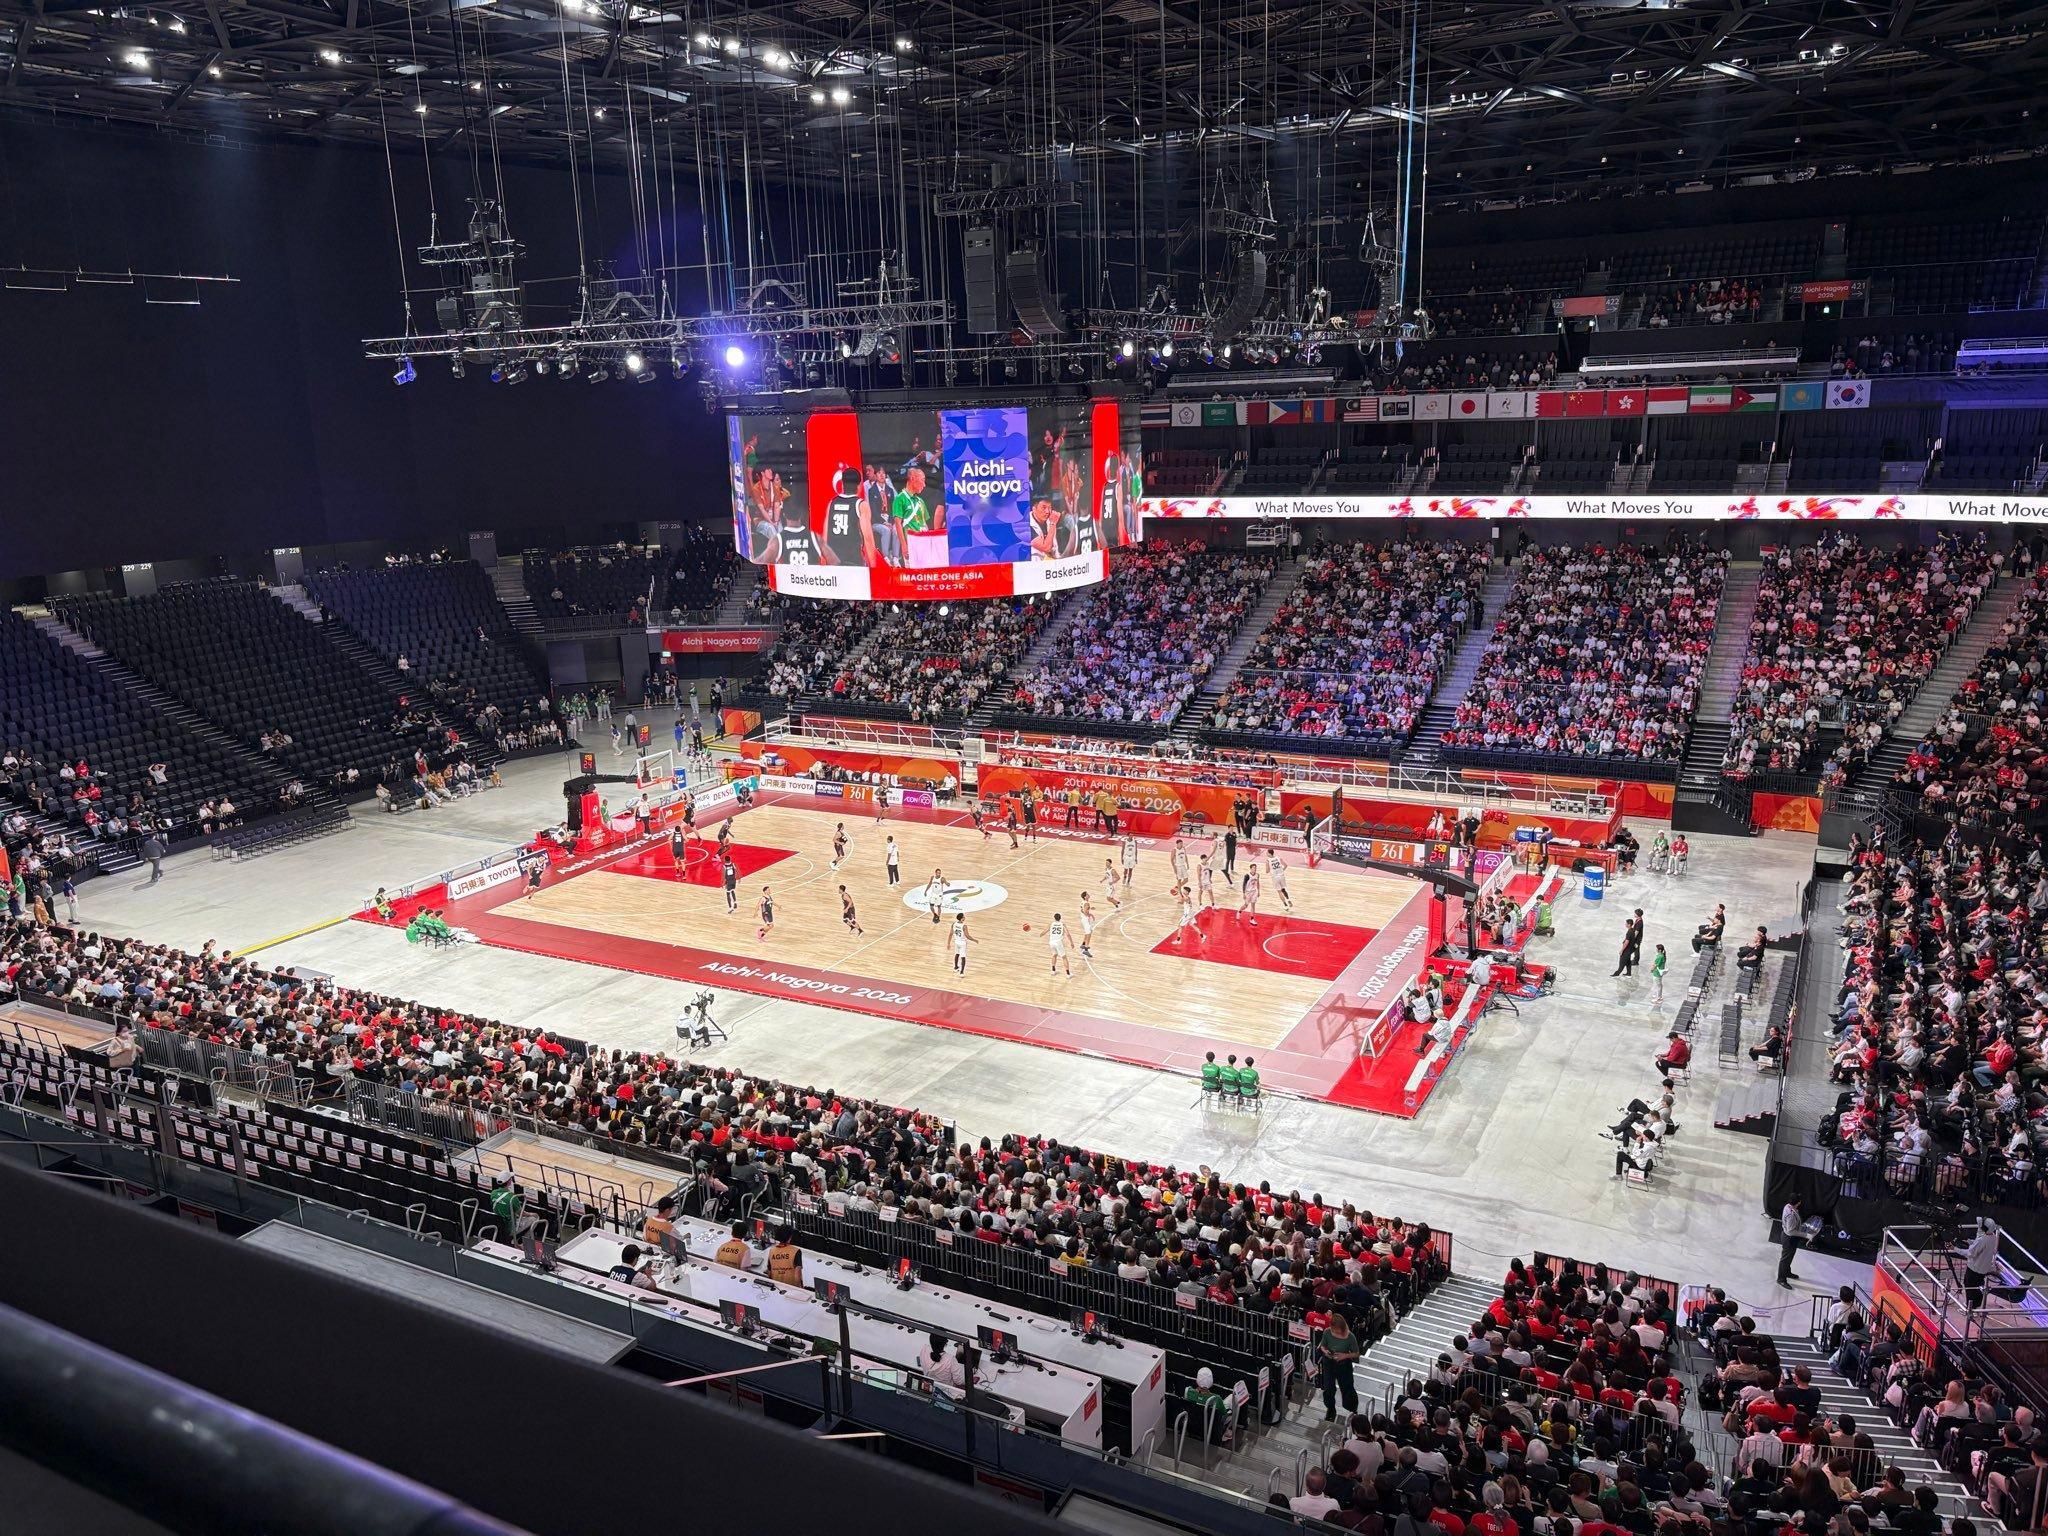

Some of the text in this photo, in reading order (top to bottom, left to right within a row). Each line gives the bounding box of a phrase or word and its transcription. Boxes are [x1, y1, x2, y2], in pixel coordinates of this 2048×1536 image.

[1804, 285, 1849, 294] Aichi-Nagoya
[1851, 282, 1866, 290] 421
[961, 458, 1014, 478] Aichi-
[953, 479, 1022, 498] Nagoya
[1255, 501, 1360, 513] What Moves You
[1566, 500, 1693, 514] What Moves You
[1948, 500, 1996, 516] What
[833, 513, 849, 535] 34
[900, 571, 984, 582] IMAGINE ONE ASIA
[1045, 562, 1090, 580] Basketball
[790, 573, 837, 587] Basketball
[682, 637, 763, 647] Aichi-Nagoya 2026
[788, 781, 815, 791] TOYOTA
[1063, 777, 1159, 795] 20th Asian Games
[1144, 796, 1182, 812] 2026
[1252, 831, 1290, 844] JR東海
[1429, 852, 1445, 863] 24
[1271, 861, 1281, 870] 32
[454, 866, 519, 896] JR東海 TOYOTA
[1051, 926, 1062, 935] 25
[699, 961, 913, 1005] Aichi-Nagoya 2026
[647, 1226, 661, 1234] AGN
[721, 1246, 740, 1255] AGNS
[771, 1253, 790, 1261] AGNS
[609, 1271, 628, 1282] RHB
